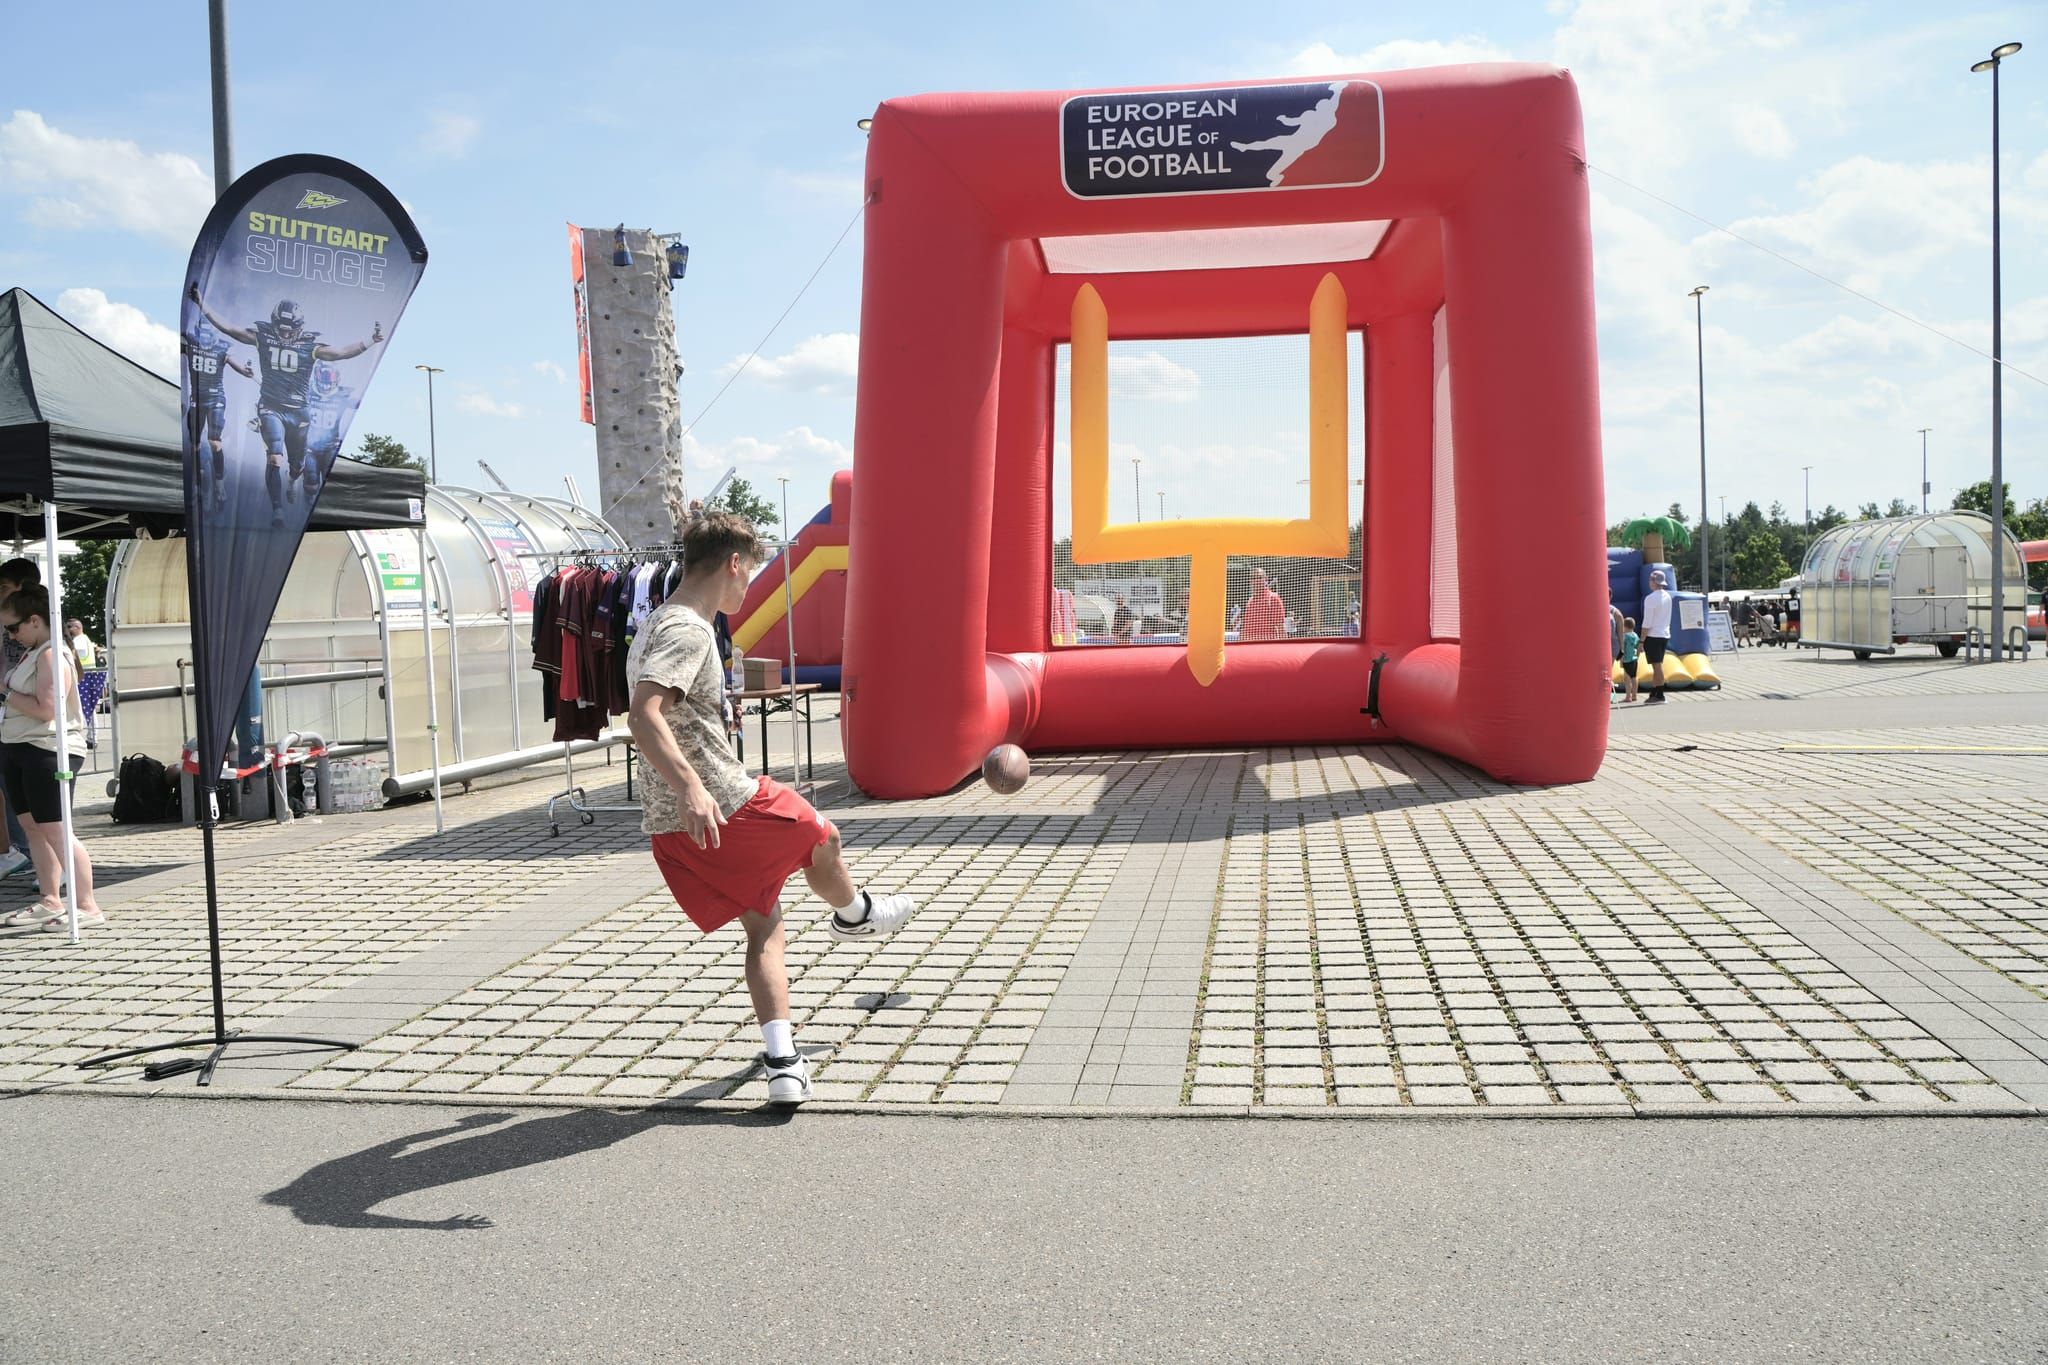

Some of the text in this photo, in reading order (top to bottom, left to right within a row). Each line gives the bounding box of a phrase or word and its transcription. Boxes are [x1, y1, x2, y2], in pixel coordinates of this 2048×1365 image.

[1087, 98, 1237, 124] EUROPEAN
[1087, 124, 1219, 151] LEAGUE OF
[1088, 151, 1231, 180] FOOTBALL
[248, 211, 389, 255] STUTTGART
[246, 234, 387, 292] SURGE
[191, 355, 218, 375] 86
[268, 346, 299, 374] 10
